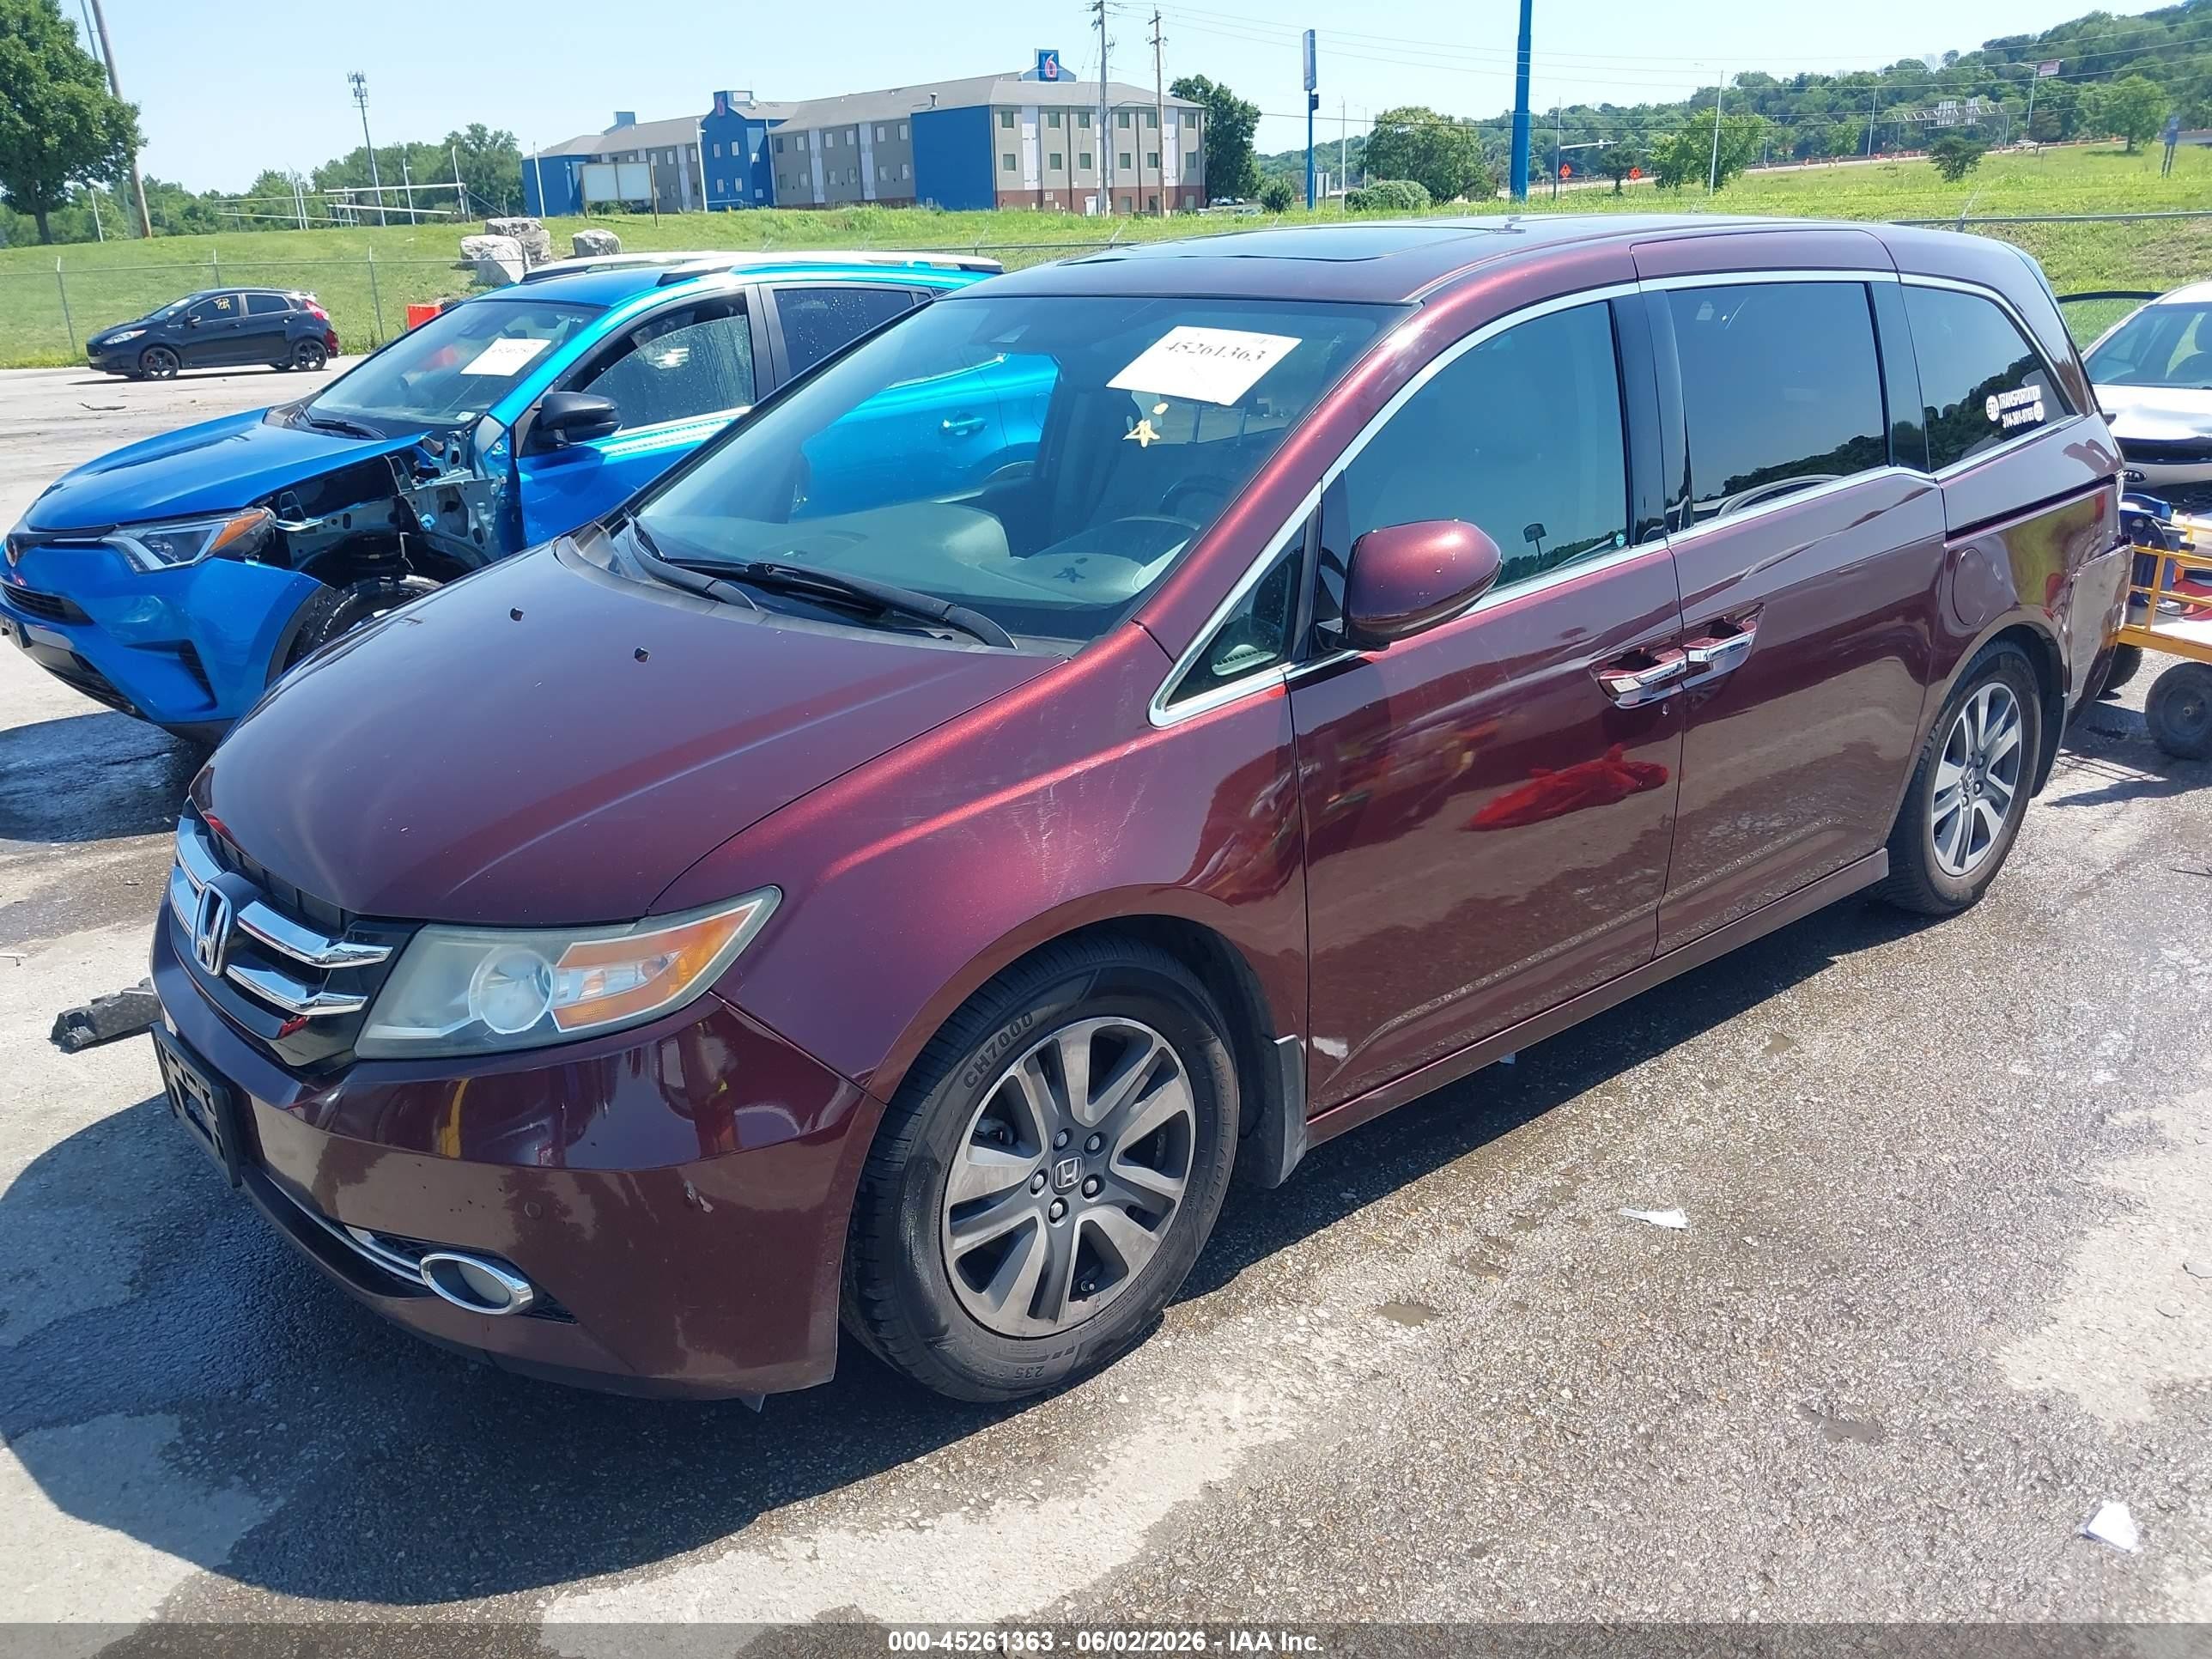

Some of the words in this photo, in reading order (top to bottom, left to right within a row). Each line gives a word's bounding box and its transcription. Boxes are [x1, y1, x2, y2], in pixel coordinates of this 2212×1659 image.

[1044, 53, 1057, 78] 6
[1165, 342, 1267, 361] 45261363
[963, 1012, 1033, 1088] CH7000
